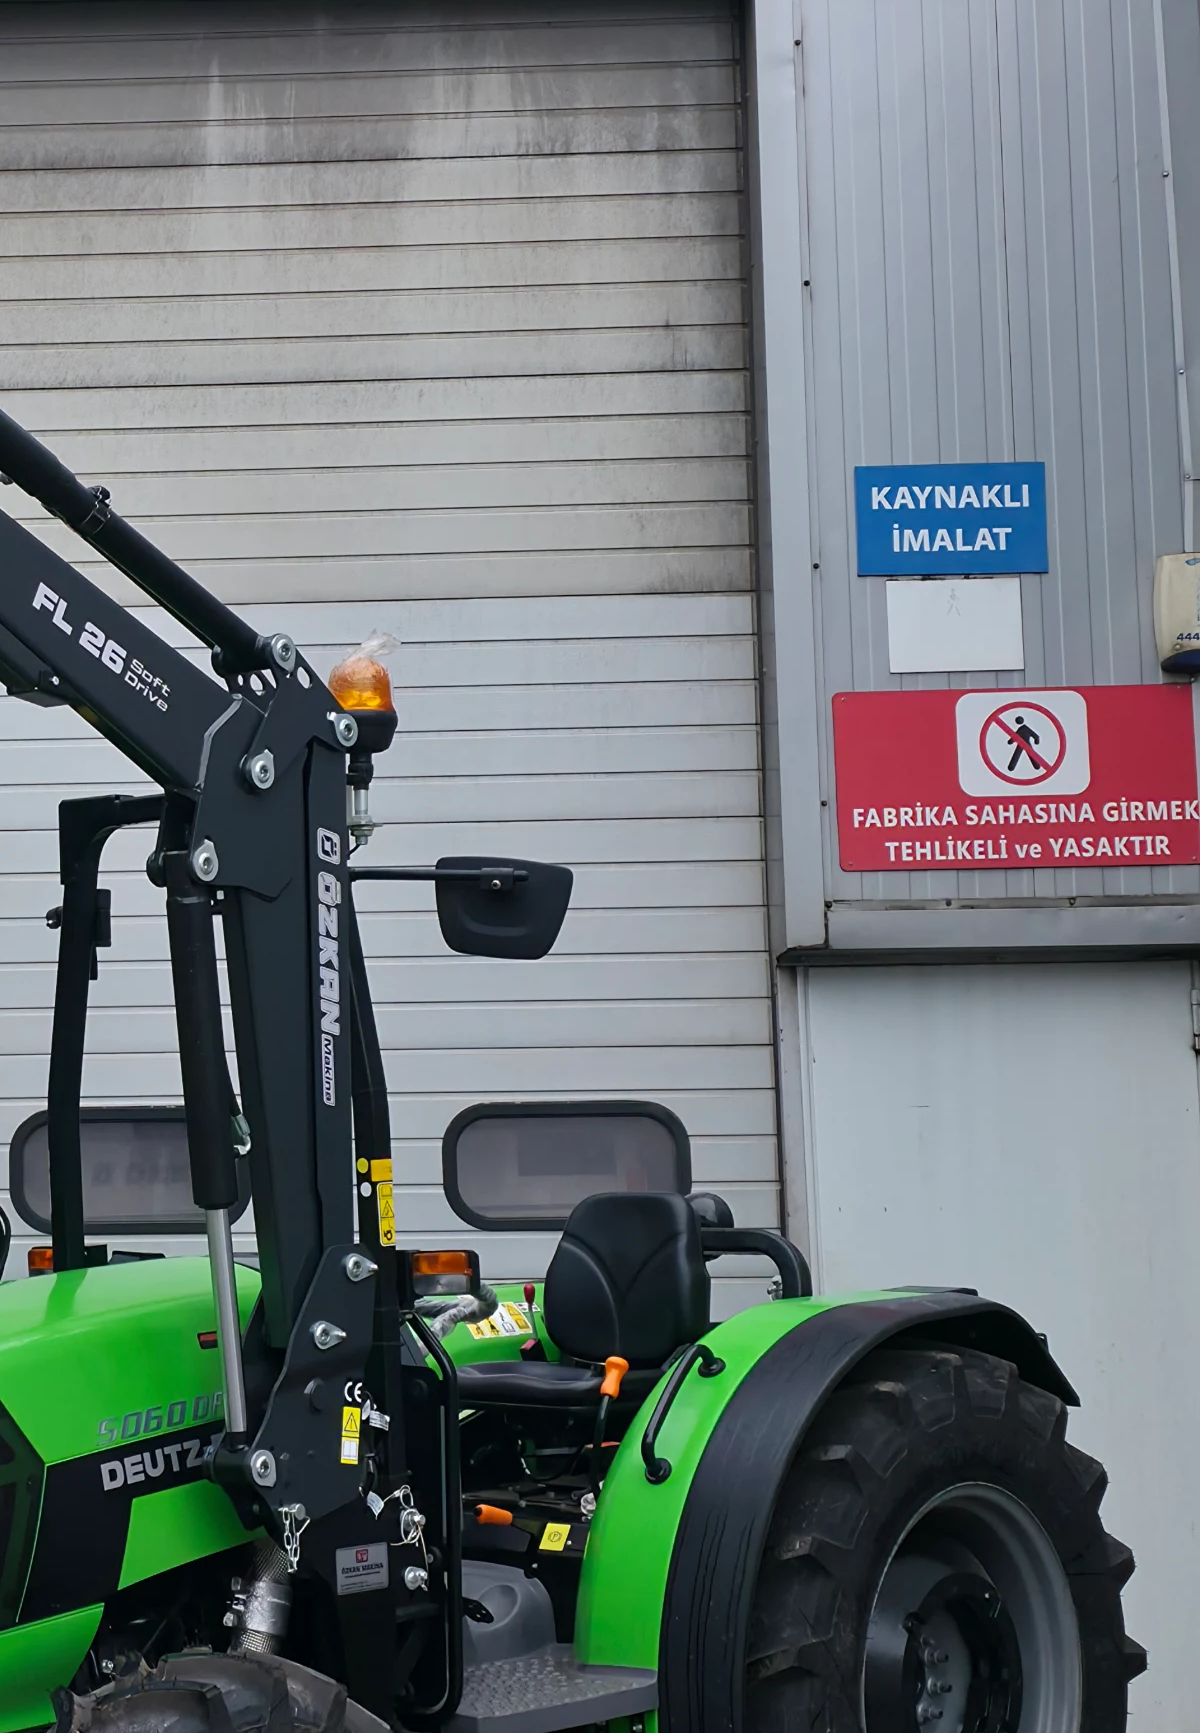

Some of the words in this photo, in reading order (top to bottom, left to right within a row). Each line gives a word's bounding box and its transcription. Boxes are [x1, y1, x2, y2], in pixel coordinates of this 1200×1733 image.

[871, 484, 1030, 510] KAYNAKLI
[892, 523, 1012, 553] İMALAT
[32, 581, 73, 636] FL
[78, 621, 127, 675] 26
[124, 670, 169, 712] Drive
[130, 658, 171, 697] Soft
[853, 802, 958, 828] FABRİKA
[966, 803, 1095, 826] SAHASINA
[1102, 796, 1199, 823] GİRMEK
[885, 834, 1008, 862] TEHLİKELİ
[1015, 841, 1042, 859] ve
[1049, 835, 1171, 857] YASAKTIR
[317, 871, 342, 1036] ÖZKAN
[96, 1400, 187, 1447] 5060
[100, 1433, 224, 1491] DEUTZ
